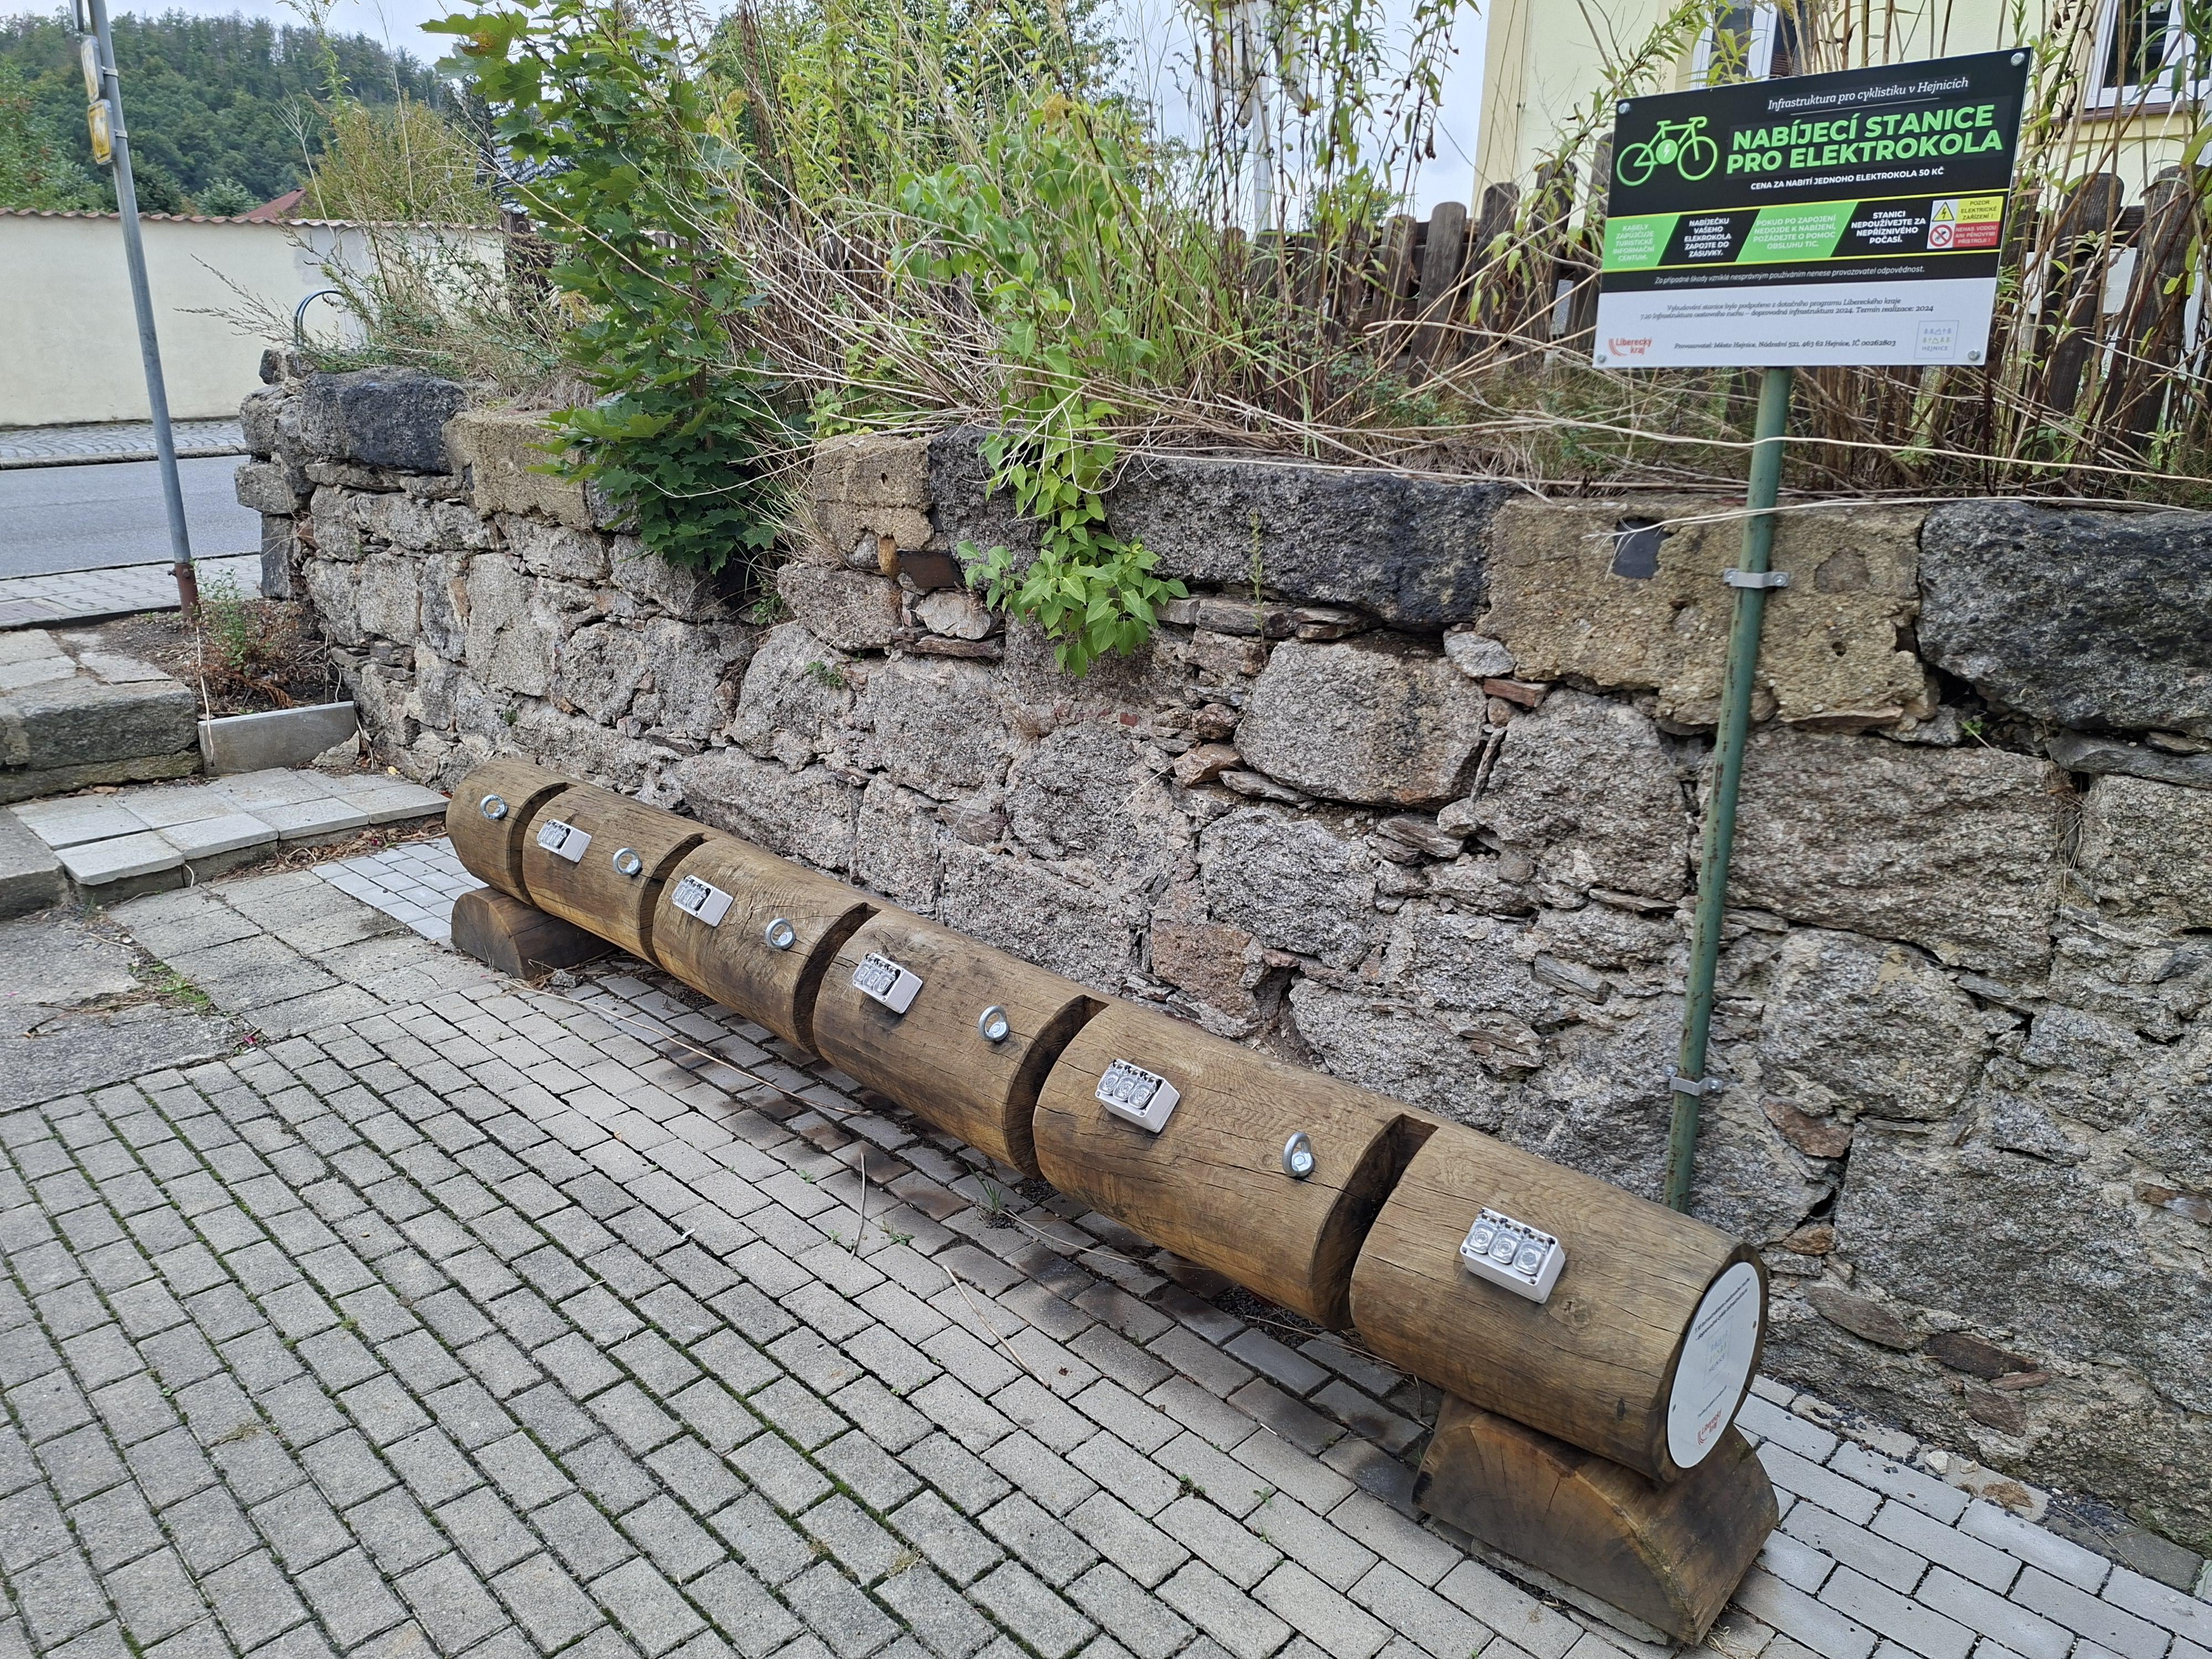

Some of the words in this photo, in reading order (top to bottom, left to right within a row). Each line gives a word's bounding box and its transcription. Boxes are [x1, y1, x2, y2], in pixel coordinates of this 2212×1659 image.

[1768, 94, 1836, 111] Infrastruktura
[1838, 91, 1855, 104] pro
[1858, 86, 1906, 101] cyklistiku
[1917, 77, 1968, 93] Hejnicích
[1733, 113, 1860, 151] NABÍJECÍ
[1865, 105, 1995, 138] STANICE
[1726, 151, 1782, 174] PRO
[1790, 130, 2003, 168] ELEKTROKOLA
[1751, 180, 1772, 190] CENA
[1773, 180, 1785, 188] ZA
[1786, 176, 1813, 187] NABITÍ
[1814, 175, 1854, 184] JEDNOHO
[1856, 170, 1917, 181] ELEKTROKOLA
[1932, 166, 1944, 175] KČ
[1872, 210, 1906, 219] STANICI
[1689, 217, 1729, 227] NABÍJEČKU
[1755, 218, 1783, 227] POKUD
[1797, 213, 1836, 224] ZAPOJENÍ
[1851, 218, 1913, 228] NEPOUŽÍVEJTE
[1616, 230, 1654, 239] ZAPŮJČUJE
[1754, 226, 1789, 234] NEDOJDE
[1856, 227, 1918, 237] NEPŘÍZNIVÉHO
[1684, 233, 1732, 242] ELEKROKOLA
[1752, 234, 1796, 242] POŽÁDEJTE
[1806, 231, 1835, 239] POMOC
[1869, 235, 1902, 244] POČASÍ.
[1616, 238, 1653, 247] TURISTICKÉ
[1767, 241, 1803, 249] OBSLUHU
[1613, 246, 1655, 254] INFORMAČNÍ
[1663, 275, 1689, 285] případné
[1690, 275, 1708, 283] škody
[1709, 273, 1730, 281] vzniklé
[1730, 272, 1768, 281] nesprávným
[1768, 270, 1806, 280] používáním
[1832, 267, 1876, 277] provozovatel
[1877, 265, 1925, 276] odpovědnost.
[1667, 304, 1701, 313] Vybudování
[1725, 302, 1738, 311] bylo
[1738, 301, 1770, 311] podpořeno
[1777, 300, 1808, 308] dotačního
[1884, 297, 1901, 306] kraje
[1652, 311, 1693, 321] Infrastruktura
[1751, 308, 1787, 317] doprovodná
[1788, 306, 1833, 316] infrastruktura
[1856, 305, 1880, 314] Termín
[1881, 304, 1914, 312] realizace:
[1616, 337, 1652, 347] Liberecký
[1733, 340, 1756, 349] Hejnice,
[1824, 339, 1850, 348] Hejnice,
[1851, 338, 1860, 347] IČ
[1630, 346, 1645, 355] kraj
